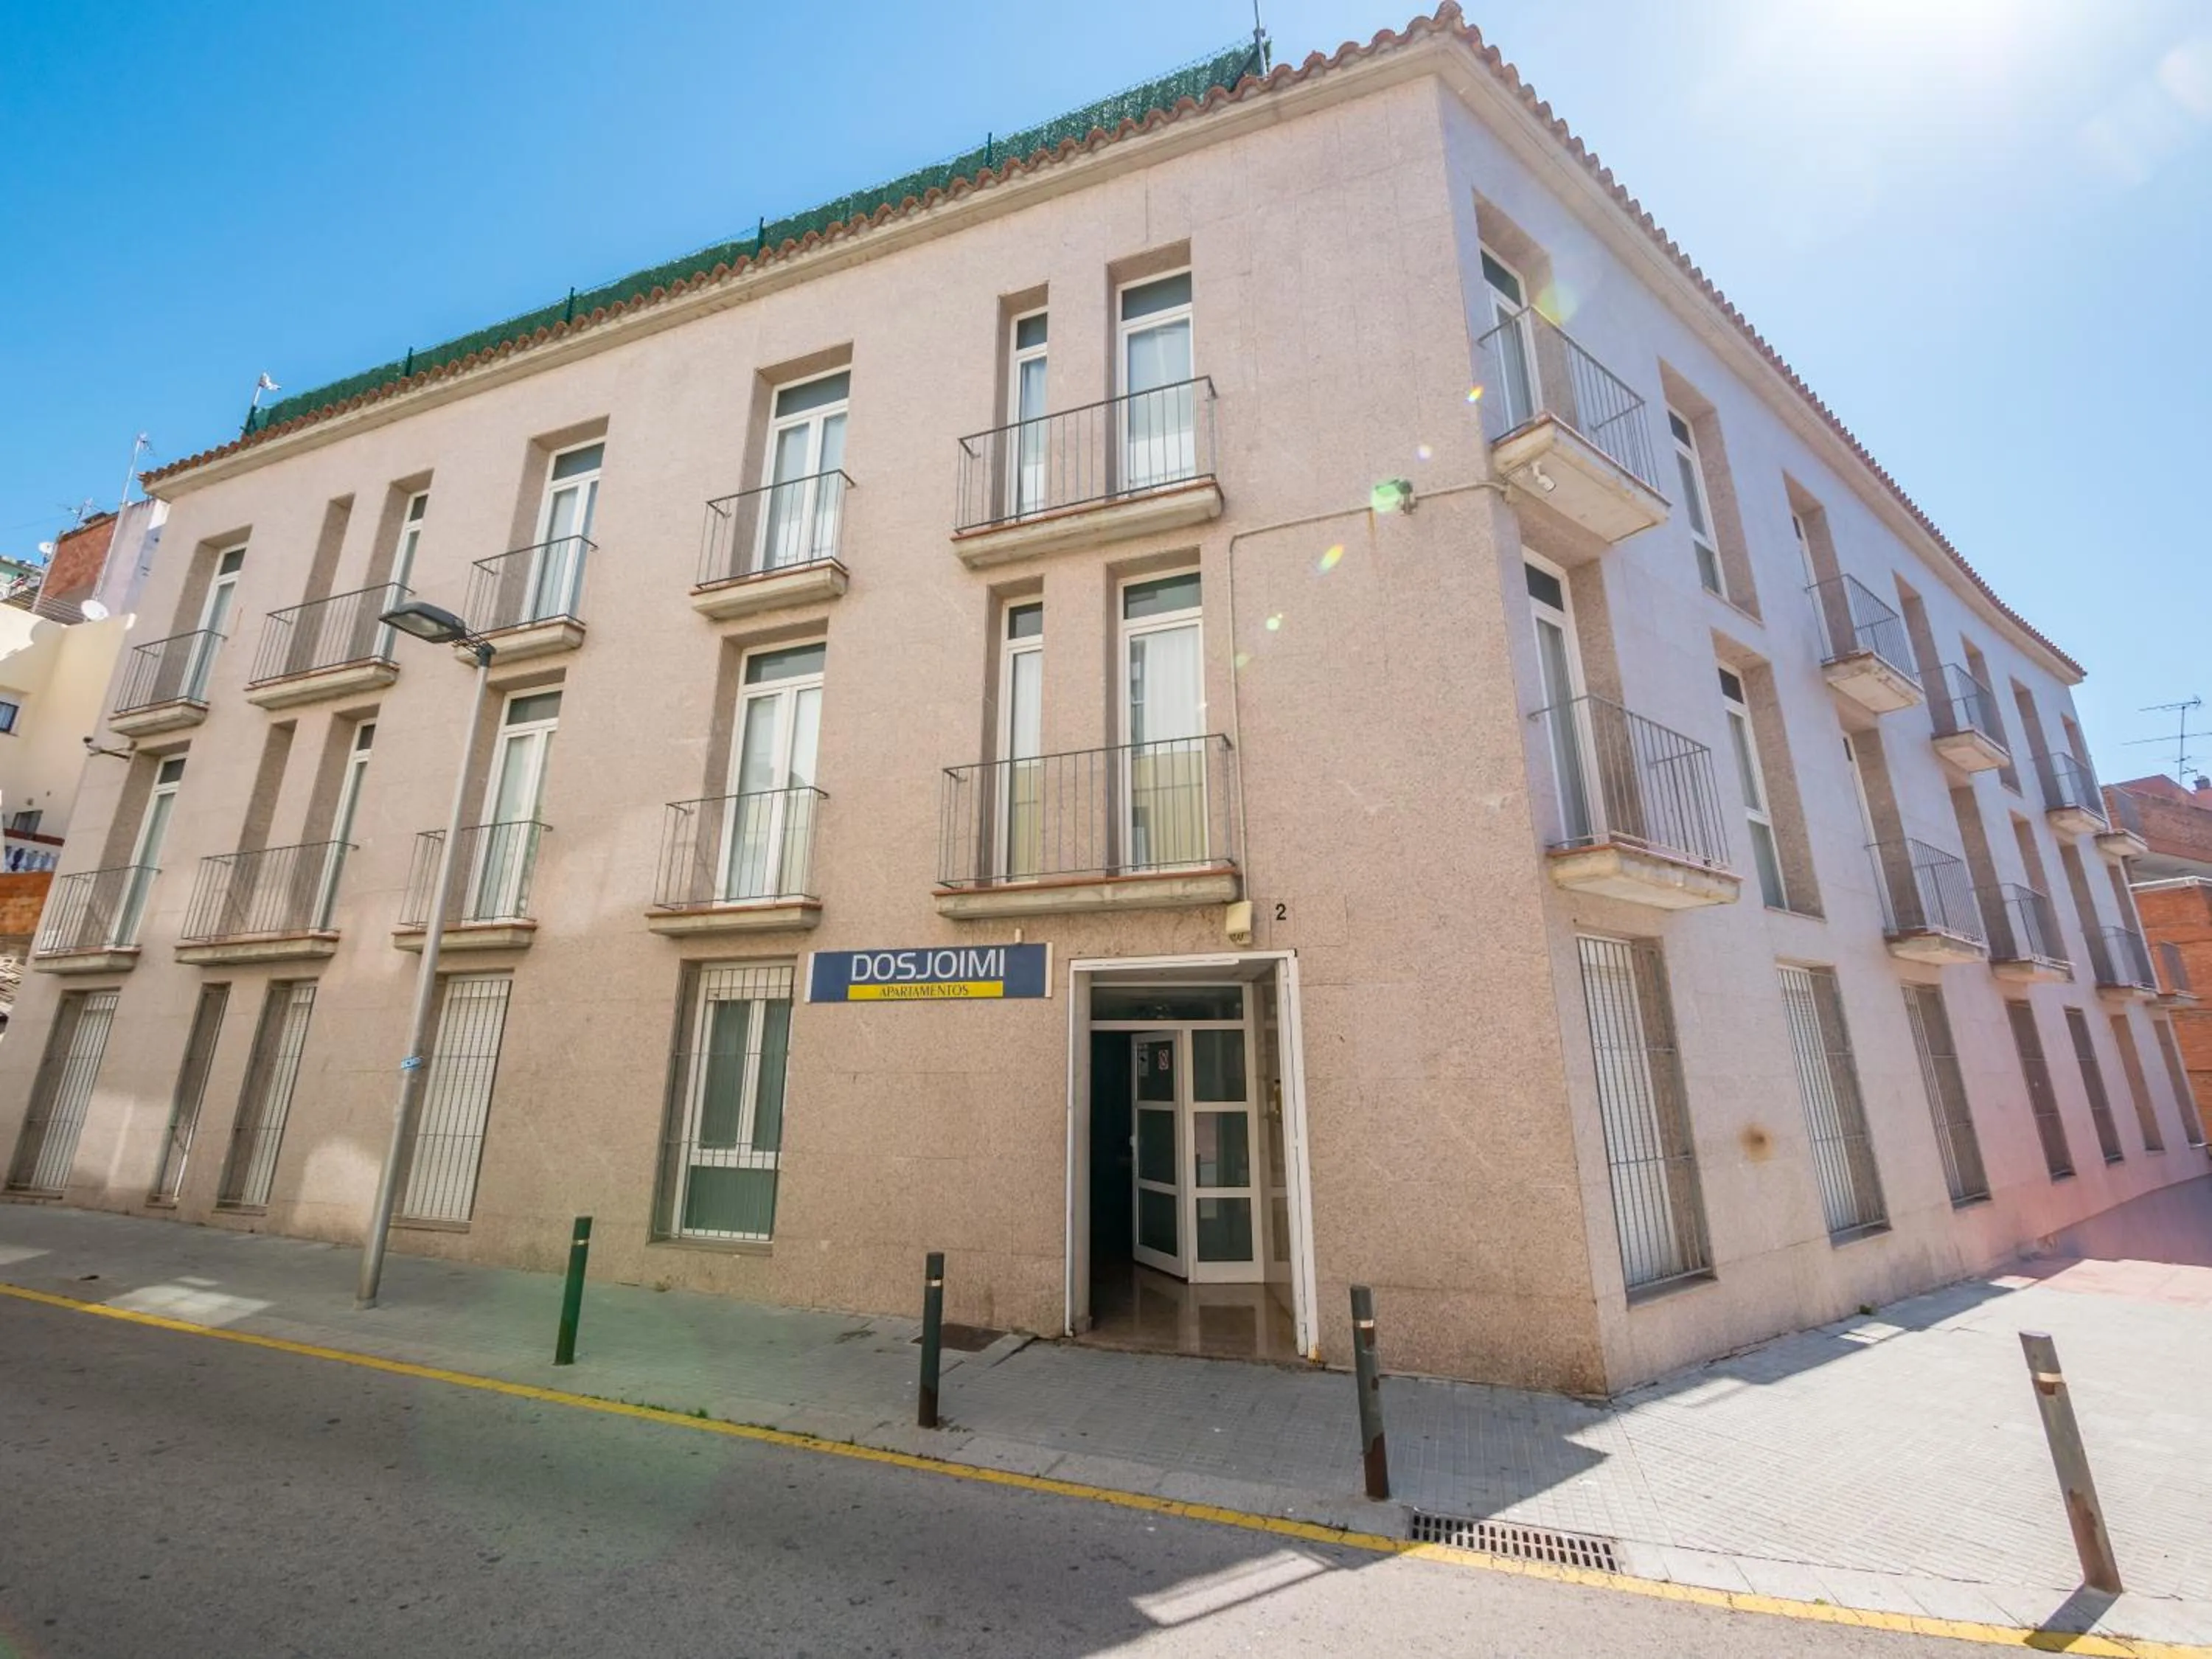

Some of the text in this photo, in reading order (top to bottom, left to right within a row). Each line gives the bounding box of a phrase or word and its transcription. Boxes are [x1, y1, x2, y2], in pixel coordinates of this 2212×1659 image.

[1275, 903, 1287, 921] 2
[851, 948, 1005, 981] DOSJOIMI
[880, 984, 970, 998] APARTAMENTOS
